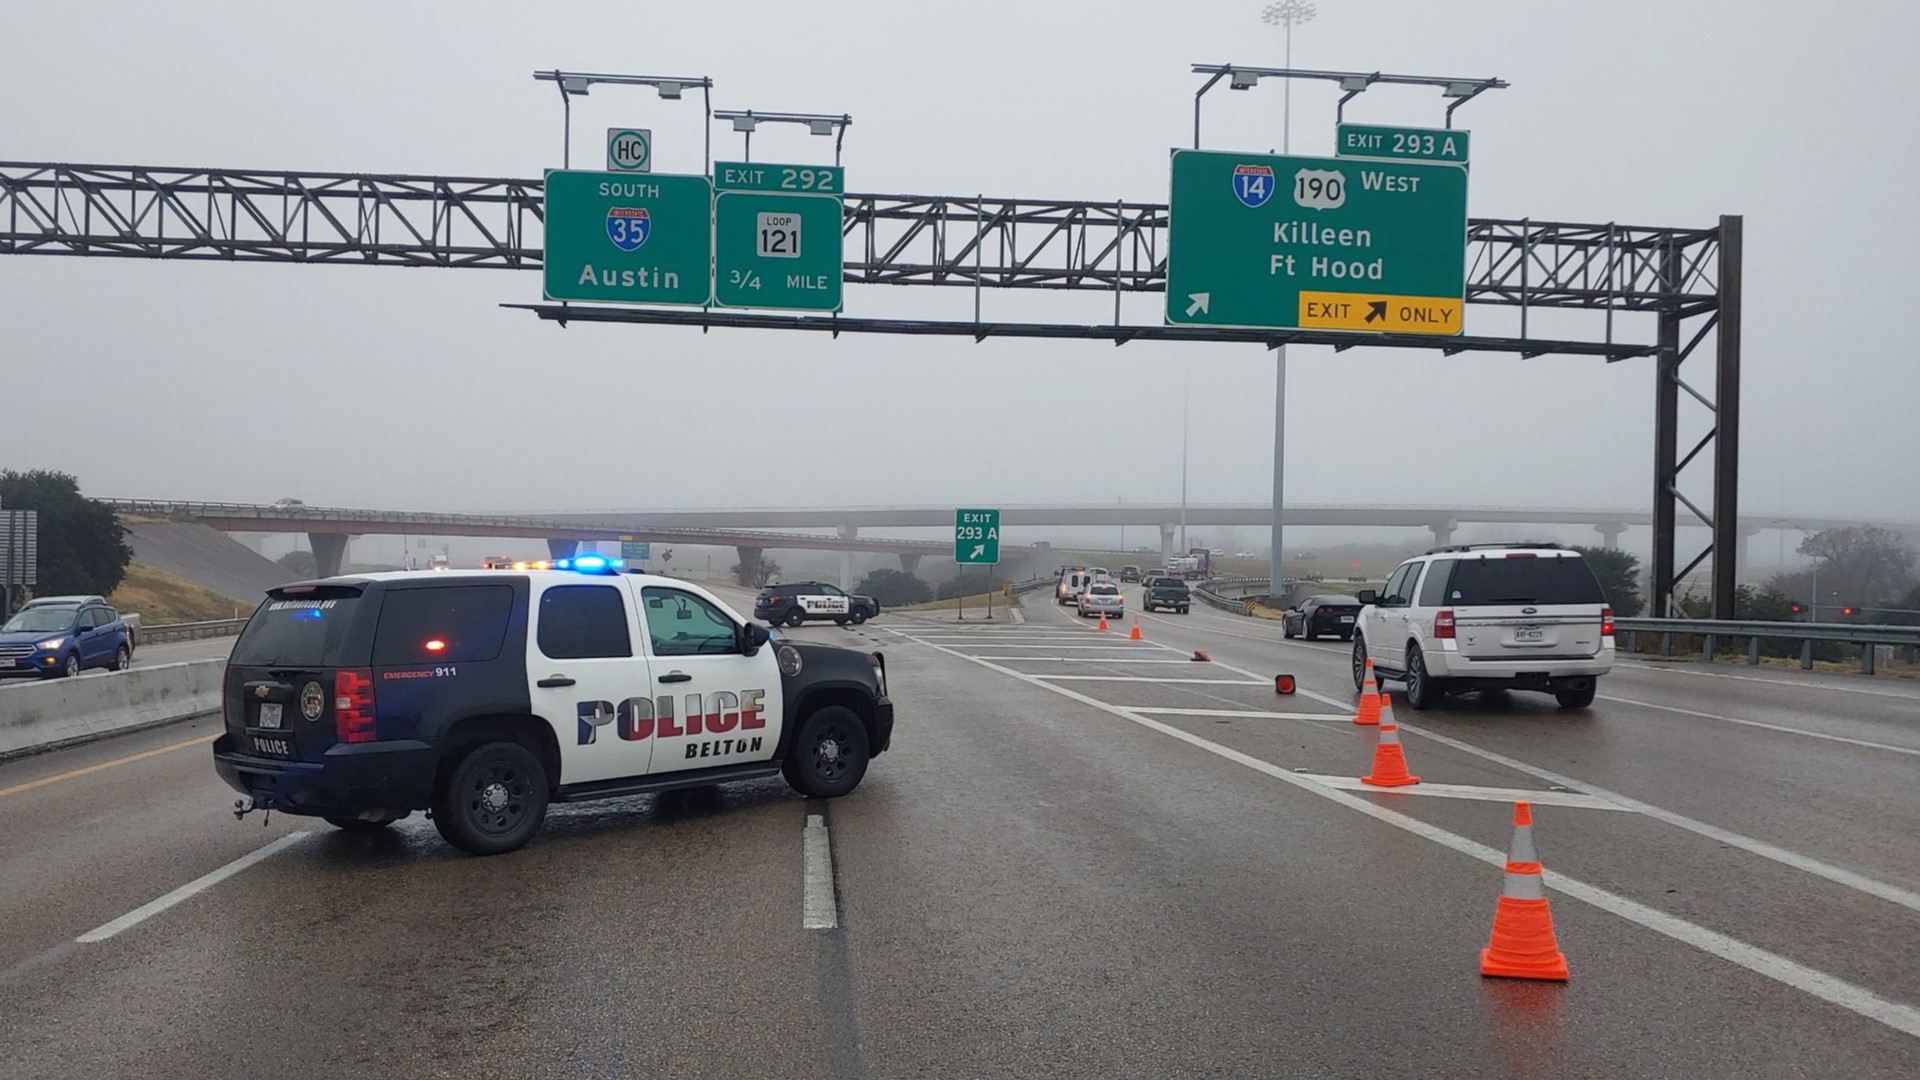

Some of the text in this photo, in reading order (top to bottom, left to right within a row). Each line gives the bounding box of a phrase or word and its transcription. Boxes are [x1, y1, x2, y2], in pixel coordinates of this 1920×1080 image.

[618, 141, 642, 160] HC
[1347, 133, 1458, 156] EXIT 293 A
[599, 182, 660, 199] SOUTH
[724, 168, 834, 191] EXIT 292
[1242, 176, 1265, 199] 14
[1298, 177, 1341, 201] 190
[1360, 170, 1421, 193] WEST
[613, 219, 644, 243] 35
[766, 216, 793, 227] LOOP
[761, 229, 798, 254] 121
[1273, 221, 1372, 248] Killeen
[578, 264, 680, 289] Austin
[1270, 254, 1384, 280] Ft Hood
[729, 269, 828, 291] 3/4 MILE
[1307, 302, 1454, 324] EXIT ONLY
[963, 513, 992, 524] EXIT
[956, 526, 998, 540] 293 A
[807, 600, 845, 609] POLICE
[383, 666, 457, 680] EMERGENCY 911
[577, 688, 766, 746] POLICE
[253, 737, 289, 755] POLICE
[684, 736, 763, 760] BELTON
